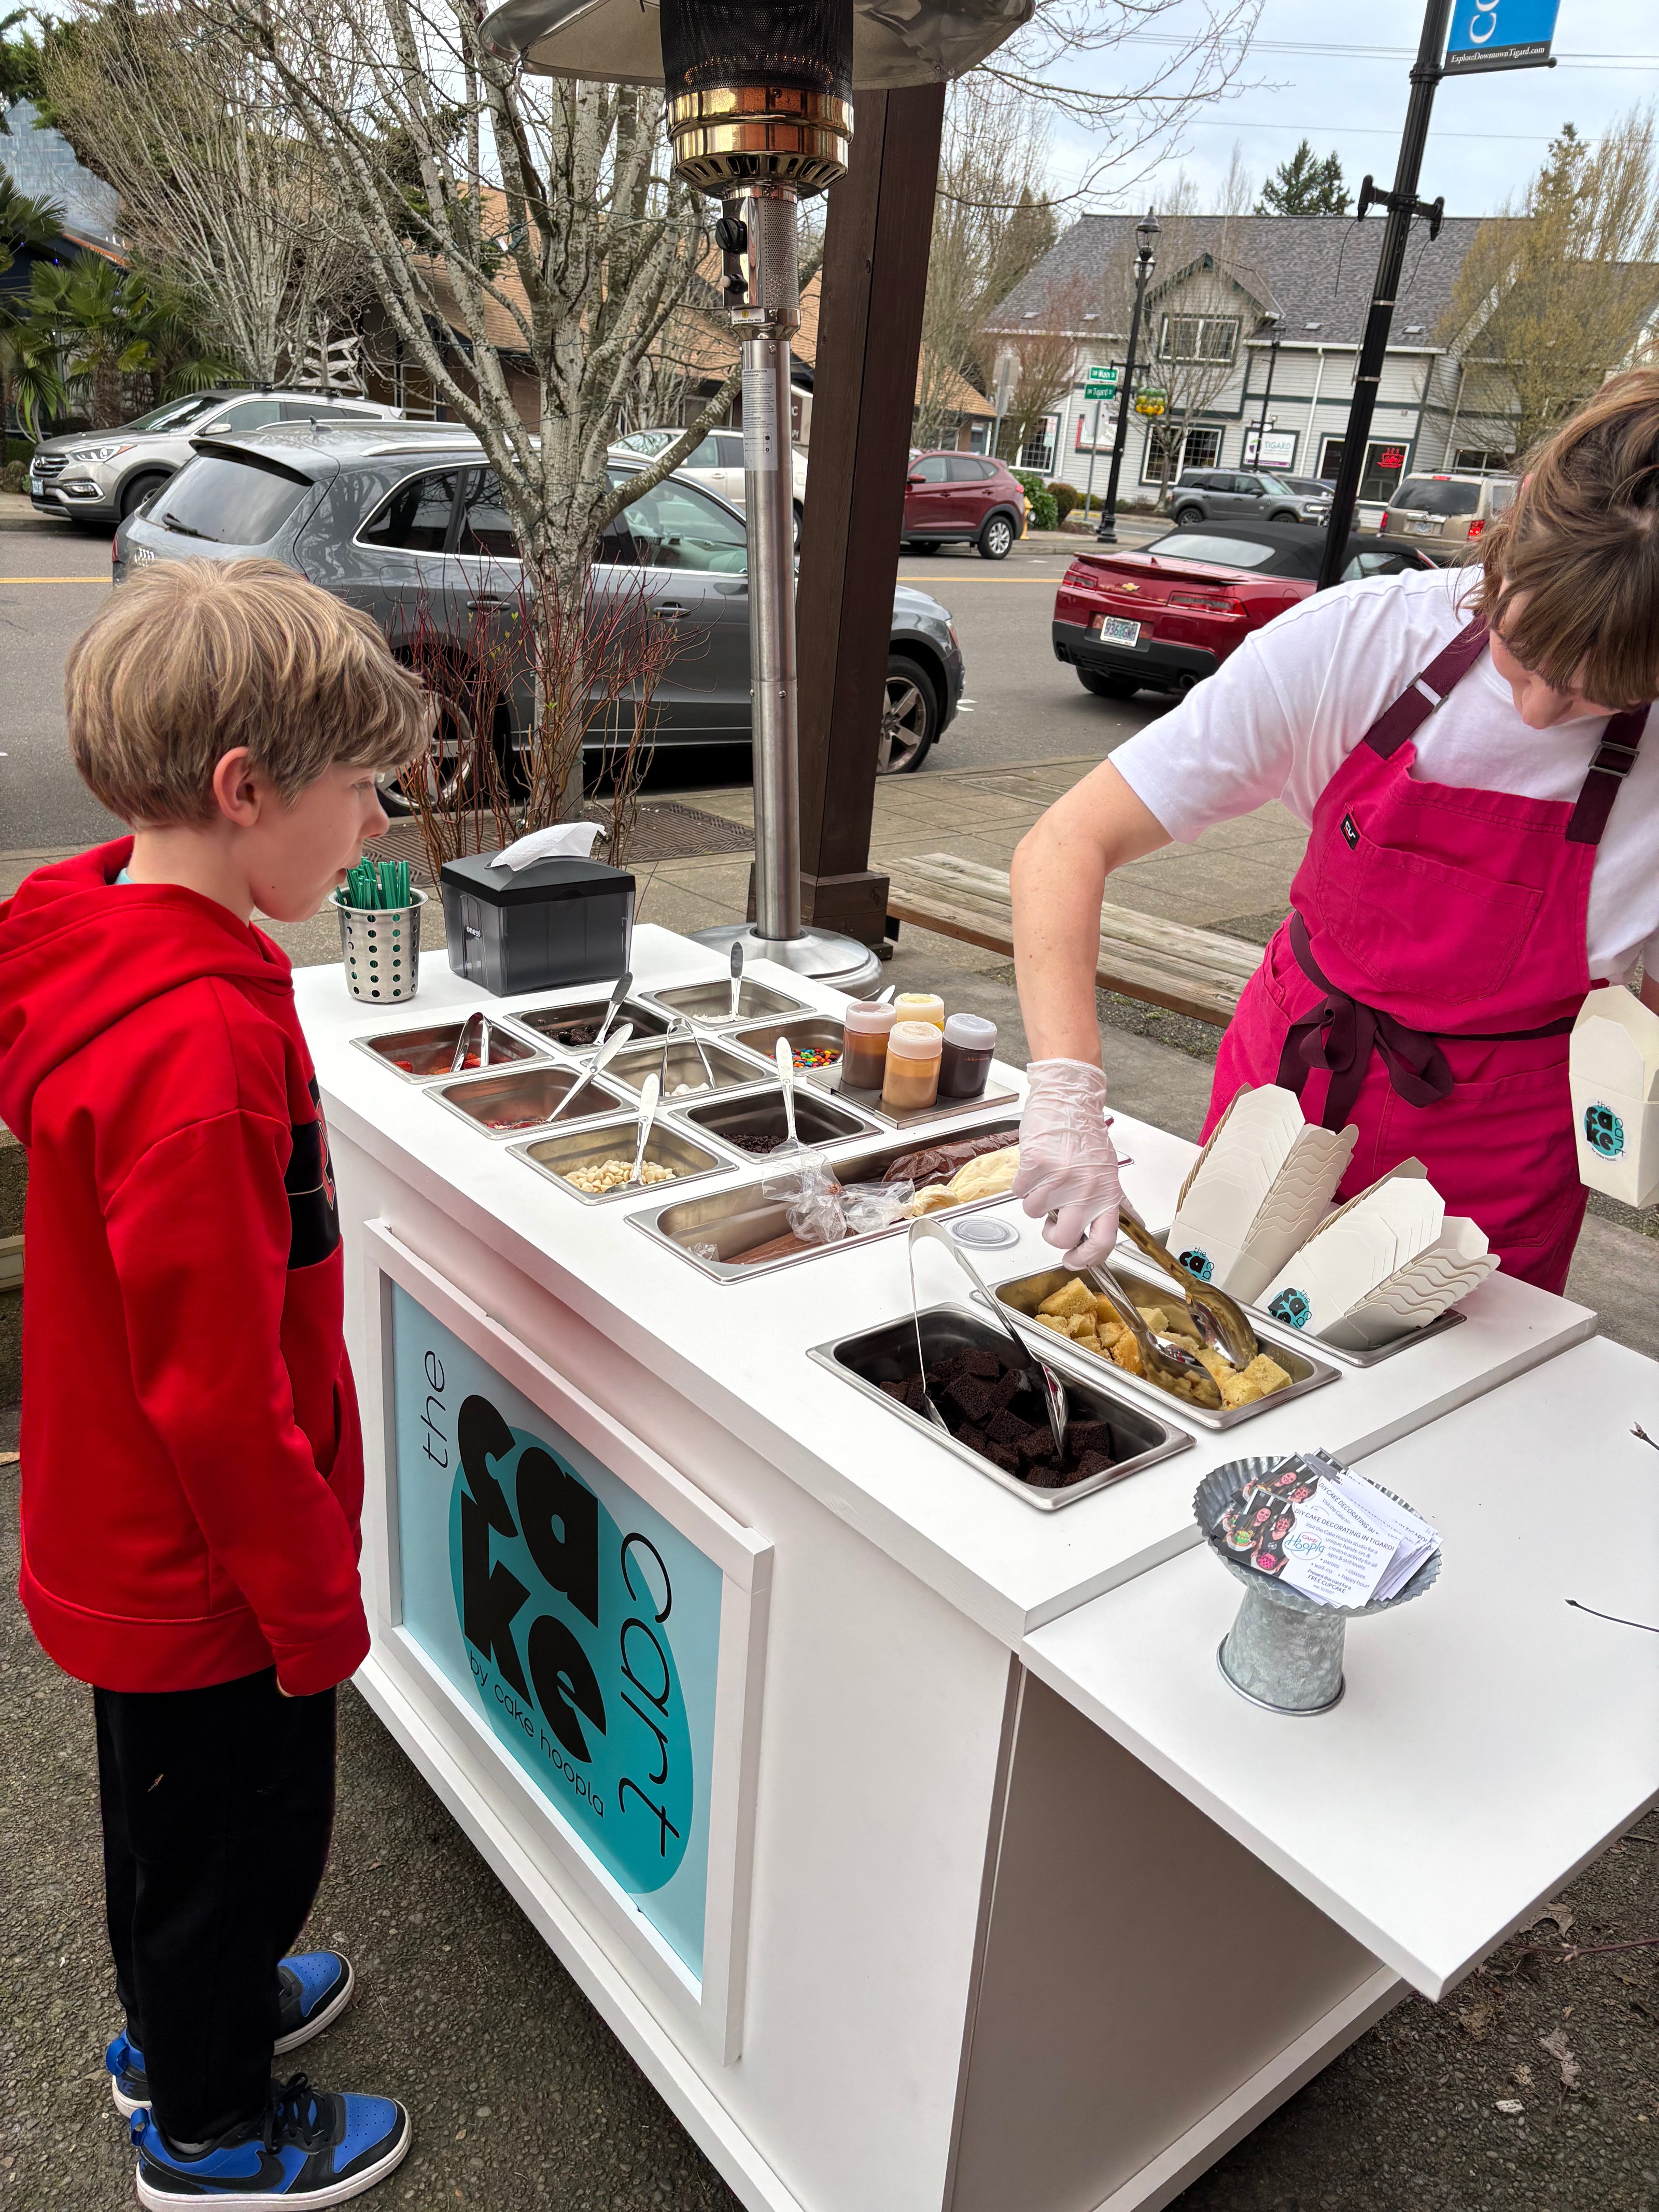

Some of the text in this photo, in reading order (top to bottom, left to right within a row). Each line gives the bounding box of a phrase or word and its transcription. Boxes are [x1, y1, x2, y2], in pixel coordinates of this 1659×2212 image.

[1451, 46, 1545, 65] ExploreDowntownTigard.com
[1264, 441, 1291, 450] TIGARD
[1105, 622, 1120, 636] 936
[1597, 1100, 1611, 1112] the
[1614, 1118, 1626, 1157] cart
[1194, 1246, 1207, 1257] the
[1300, 1289, 1311, 1304] the
[421, 1350, 448, 1469] the
[1318, 1483, 1328, 1491] DIY
[1326, 1490, 1340, 1502] CAKE
[1338, 1500, 1369, 1529] DECORATING
[1322, 1498, 1331, 1506] Visit
[1302, 1534, 1318, 1543] CAKE
[1305, 1513, 1322, 1523] CAKE
[1321, 1519, 1361, 1538] DECORATING
[1370, 1537, 1395, 1552] TIGARD!
[1284, 1533, 1326, 1555] Hoopla
[1335, 1534, 1353, 1544] Hoopla
[1353, 1542, 1368, 1550] studio
[1328, 1546, 1347, 1556] creative
[1347, 1553, 1365, 1563] activity
[1314, 1563, 1333, 1574] walk-ins
[1323, 1559, 1340, 1569] parties
[1307, 1569, 1325, 1579] Present
[1341, 1574, 1357, 1584] happy
[1348, 1570, 1366, 1579] classes
[1307, 1574, 1346, 1594] FREE CUPCAKE
[618, 1532, 680, 1857] cart
[470, 1650, 604, 1819] by cake hoopla
